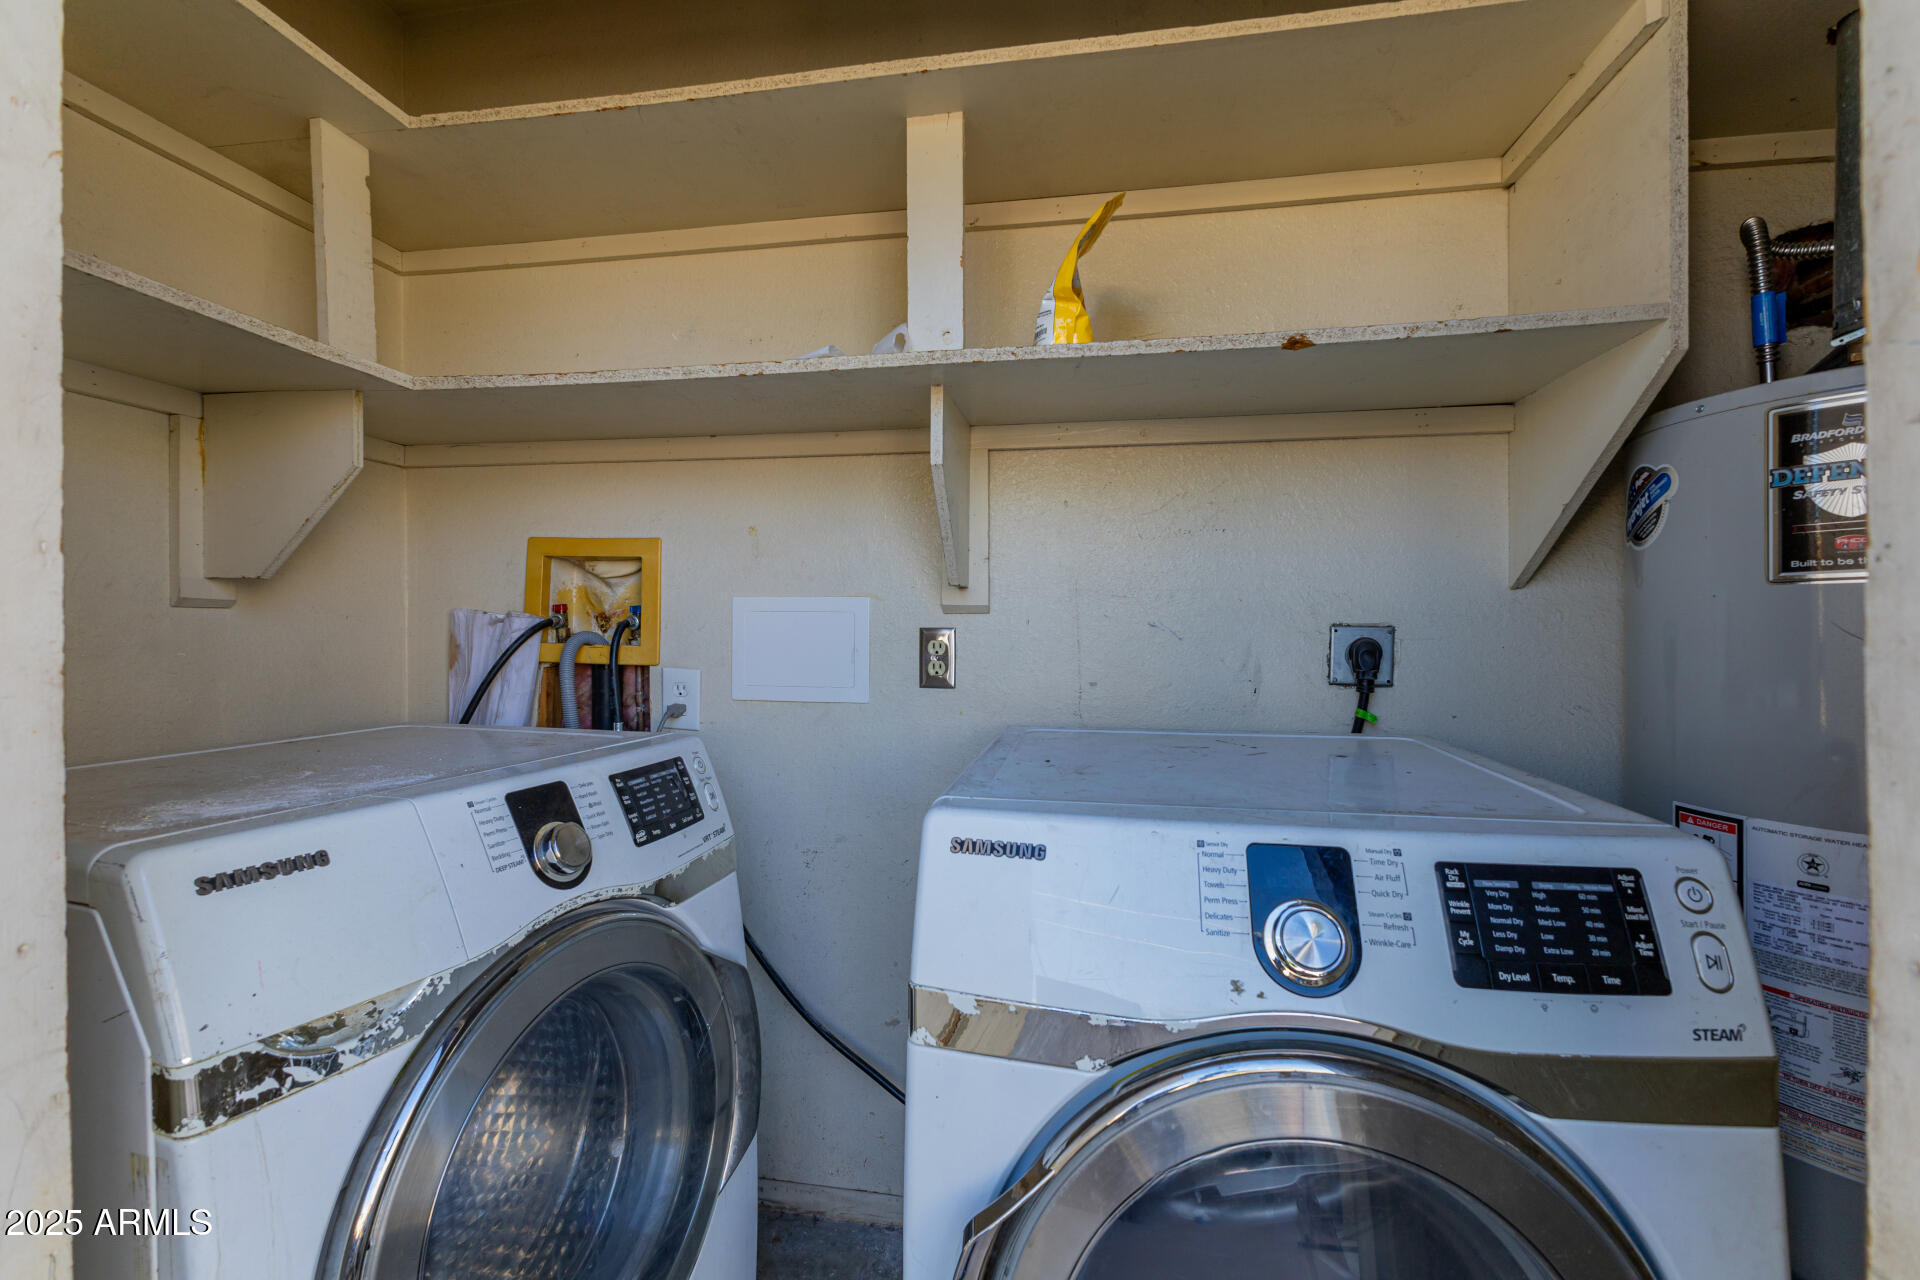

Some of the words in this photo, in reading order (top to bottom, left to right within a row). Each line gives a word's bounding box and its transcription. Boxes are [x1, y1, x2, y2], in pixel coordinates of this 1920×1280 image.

[1791, 426, 1866, 444] BRADFORD
[1793, 487, 1847, 500] SAFETY
[1837, 558, 1854, 566] be
[1697, 818, 1729, 832] DANGER
[1752, 826, 1788, 837] AUTOMATIC
[1790, 832, 1822, 842] STORAGE
[1824, 838, 1850, 847] WATER
[950, 836, 1047, 862] SAMSUNG
[1387, 859, 1398, 868] Dry
[194, 849, 330, 896] SAMSUNG
[1203, 865, 1221, 874] Heavy
[1222, 866, 1237, 876] Duty
[1675, 866, 1698, 874] Power
[1371, 889, 1390, 898] Quick
[1392, 891, 1404, 900] Dry
[1484, 890, 1498, 898] Very
[1499, 890, 1509, 898] Dry
[1204, 896, 1220, 904] Perm
[1222, 896, 1238, 905] Press
[1503, 904, 1513, 912] Dry
[1535, 905, 1560, 913] Medium
[1205, 912, 1234, 920] Delicates
[1490, 916, 1512, 924] Normal
[1513, 918, 1524, 926] Dry
[1384, 922, 1409, 932] Refresh
[1680, 920, 1698, 928] Start
[1704, 920, 1726, 930] Pause
[1206, 928, 1230, 937] Sanitize
[1460, 930, 1469, 938] My
[1506, 931, 1518, 940] Dry
[1368, 938, 1412, 949] Wrinkle-Care
[1458, 938, 1474, 946] Cycle
[1495, 944, 1514, 953] Damp
[1514, 945, 1525, 955] Dry
[1544, 946, 1560, 955] Extra
[1560, 947, 1574, 955] Low
[1499, 972, 1511, 982] Dry
[1512, 972, 1531, 982] Level
[1552, 973, 1576, 986] Temp.
[1601, 975, 1622, 985] Time
[1692, 1028, 1743, 1042] STEAM
